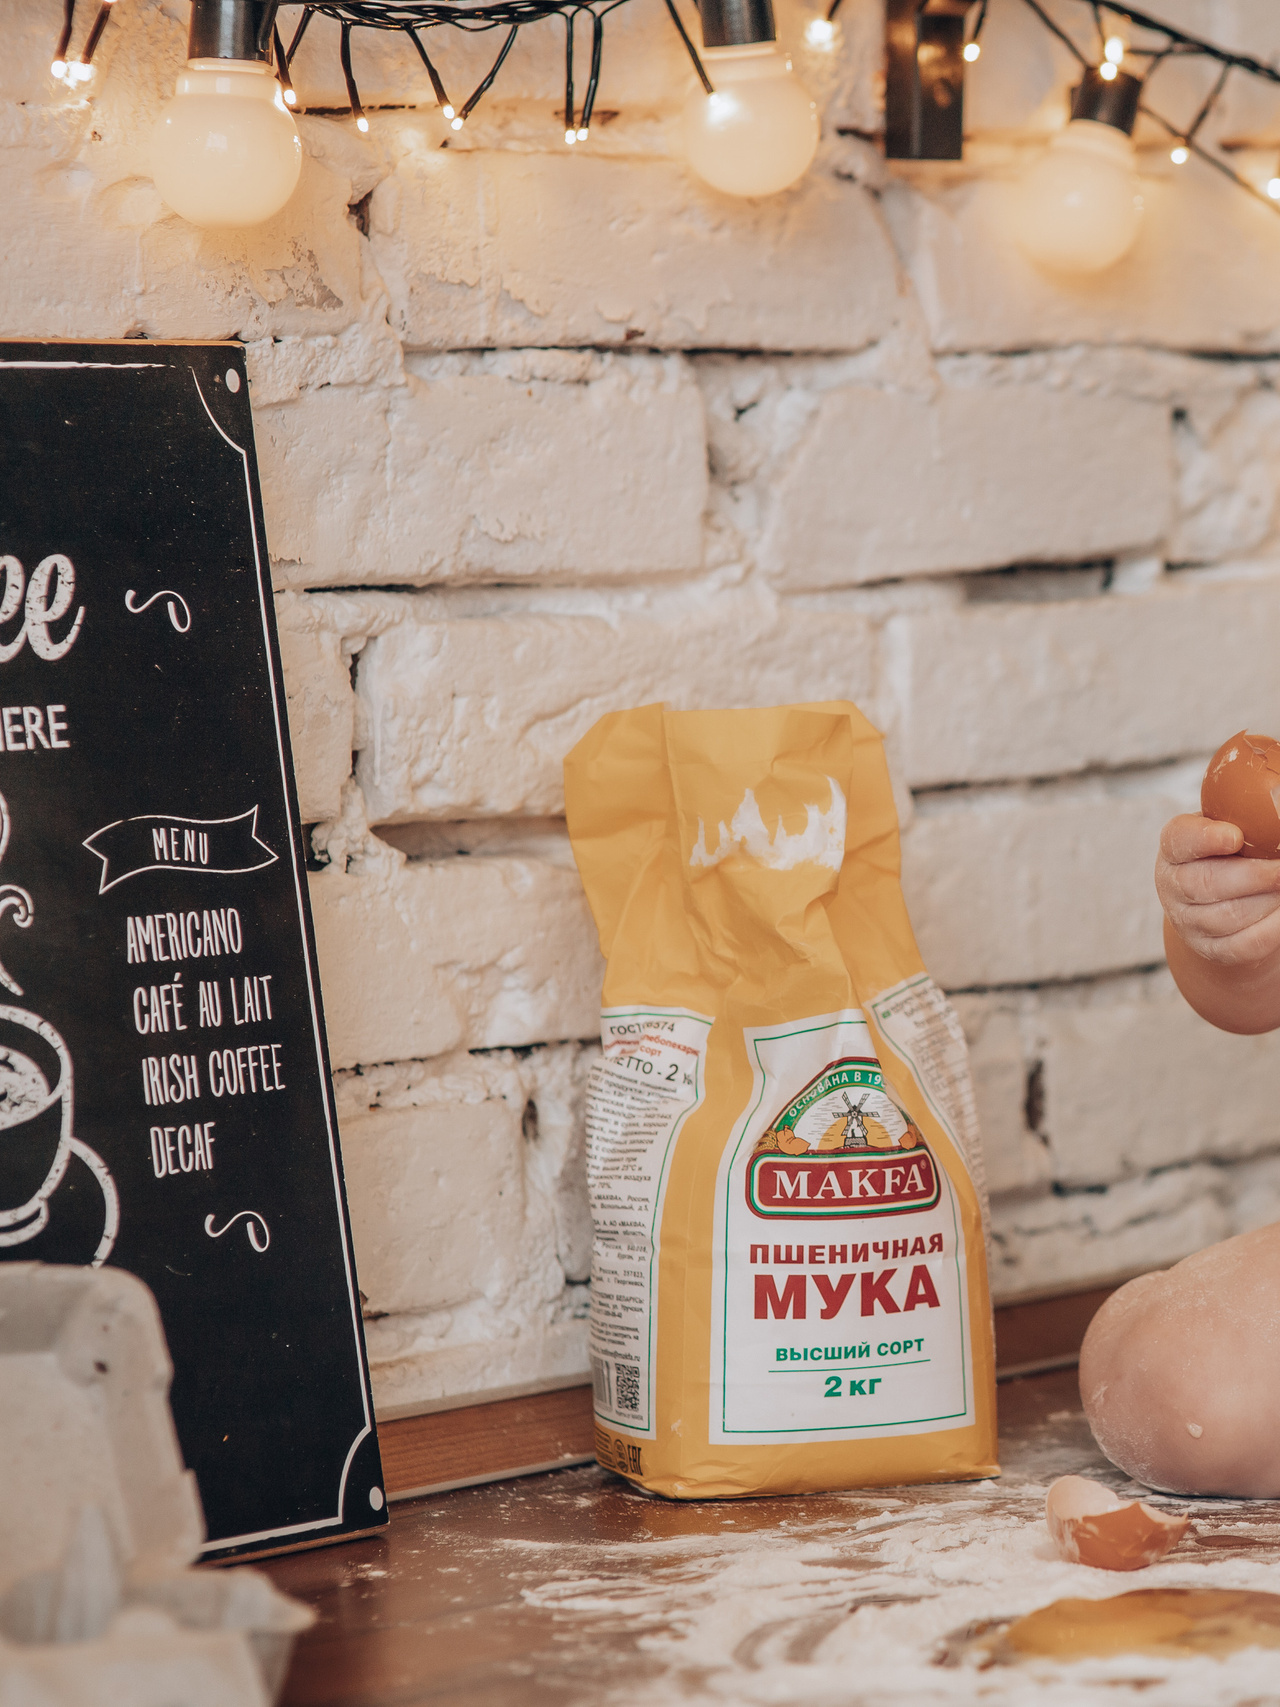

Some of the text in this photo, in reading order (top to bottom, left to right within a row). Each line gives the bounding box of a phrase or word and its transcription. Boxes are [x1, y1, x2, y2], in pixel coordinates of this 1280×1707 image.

[0, 704, 71, 752] ERE
[152, 828, 208, 865] MENU
[127, 908, 243, 964] AMERICANO
[133, 973, 272, 1034] CAFÉ AU LAIT
[142, 1044, 286, 1106] IRISH COFFEE
[665, 1063, 679, 1082] 2
[854, 1071, 861, 1082] В
[150, 1122, 216, 1179] DECAF
[772, 1164, 926, 1199] MAKFA
[750, 1233, 943, 1264] ПШЕНИЧНАЯ
[754, 1264, 941, 1320] МУКА
[776, 1338, 924, 1361] ВЫСШИЙ СОРТ
[824, 1376, 882, 1397] 2 кг
